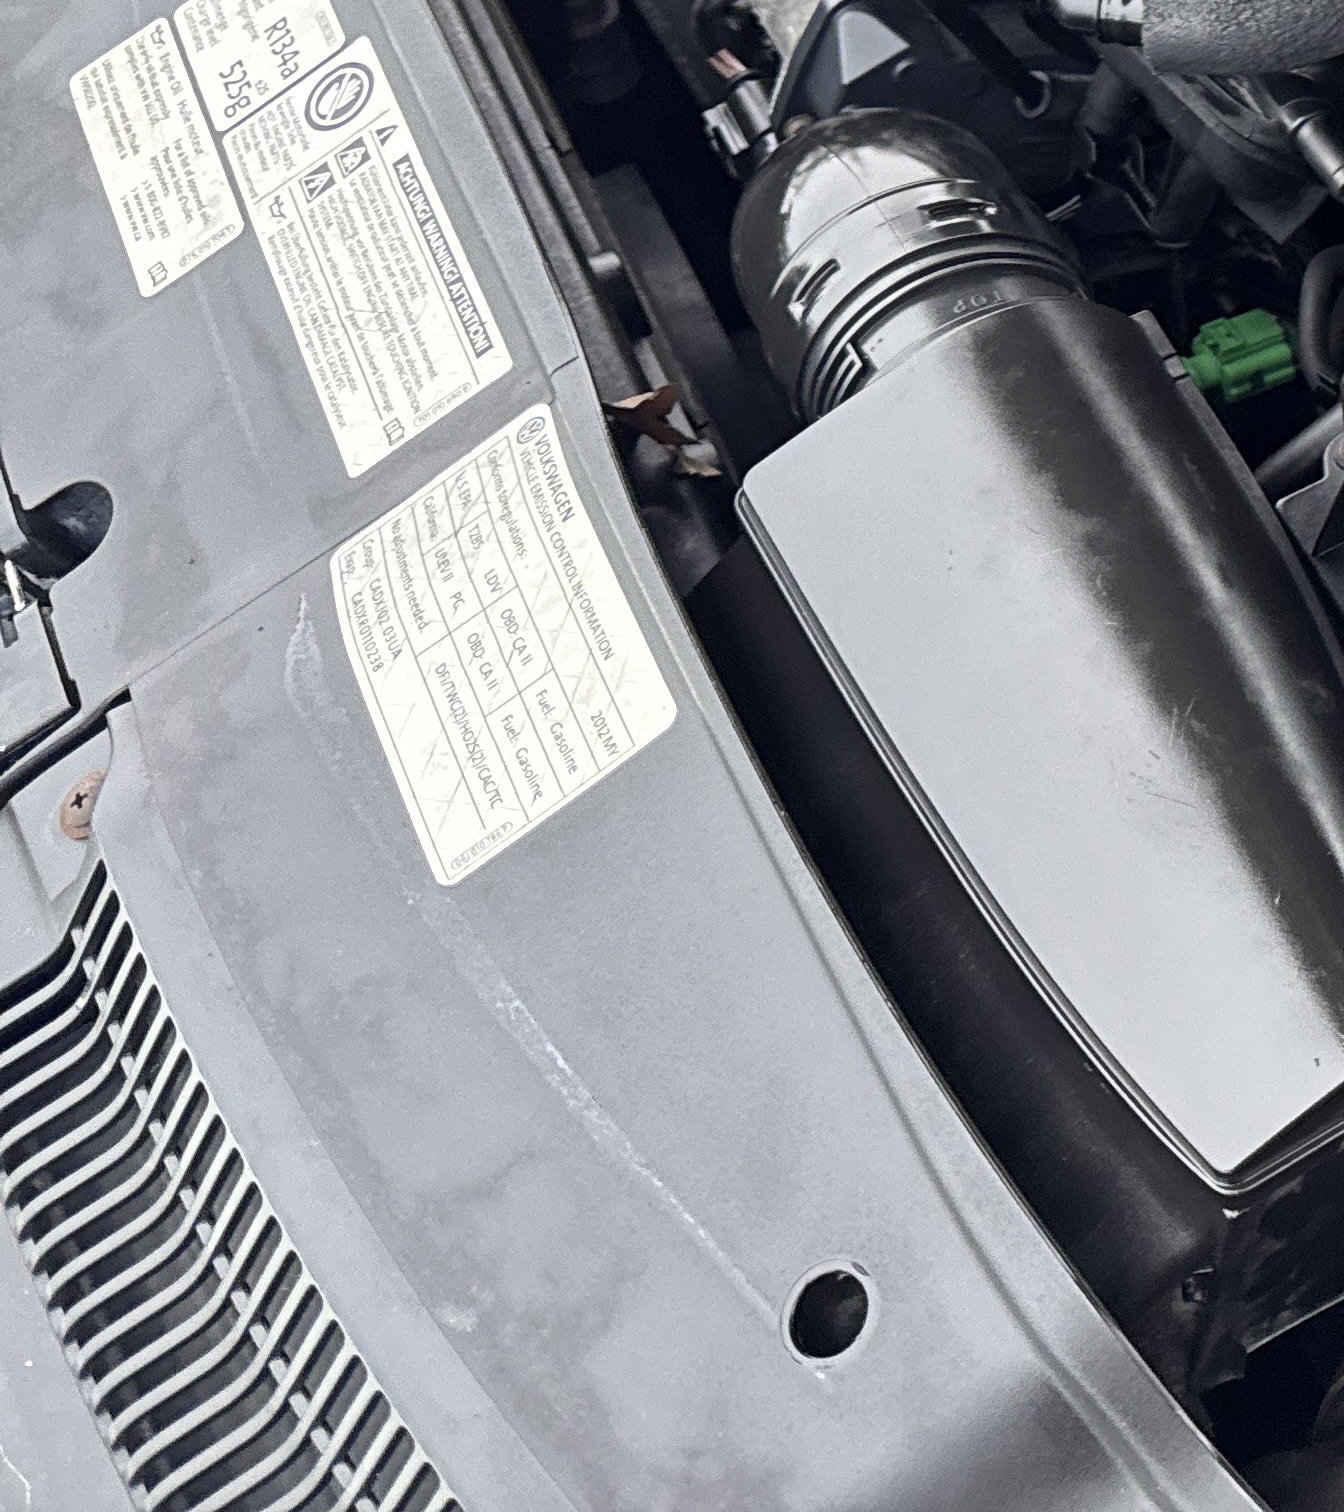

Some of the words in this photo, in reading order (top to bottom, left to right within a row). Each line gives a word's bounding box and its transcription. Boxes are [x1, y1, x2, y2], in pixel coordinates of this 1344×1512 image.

[205, 24, 222, 48] level
[263, 15, 300, 81] R134a
[158, 51, 176, 83] Engine
[169, 80, 184, 97] Oil
[218, 58, 252, 119] 525g
[395, 161, 433, 223] ACHTUNG!
[421, 218, 461, 284] WARNING!
[447, 281, 491, 353] ATTENTION!
[486, 448, 505, 493] Conforms
[518, 446, 540, 486] VEHICLE
[533, 432, 576, 523] VOLKSWAGEN
[496, 488, 512, 504] to
[528, 482, 557, 533] EMISSION
[390, 517, 402, 535] No
[498, 496, 528, 557] regulations:
[390, 532, 415, 592] adjustments
[433, 546, 452, 574] ULEV
[483, 567, 504, 593] LDV
[549, 530, 579, 584] CONTROL
[405, 589, 431, 634] needed.
[570, 579, 615, 661] INFORMATION
[511, 636, 528, 657] CA
[478, 661, 494, 681] CA
[534, 688, 556, 719] Fuel:
[549, 721, 578, 775] Gasoline
[589, 709, 611, 740] 2012
[601, 734, 620, 757] MY
[500, 713, 522, 744] Fuel:
[515, 746, 544, 805] Gasoline
